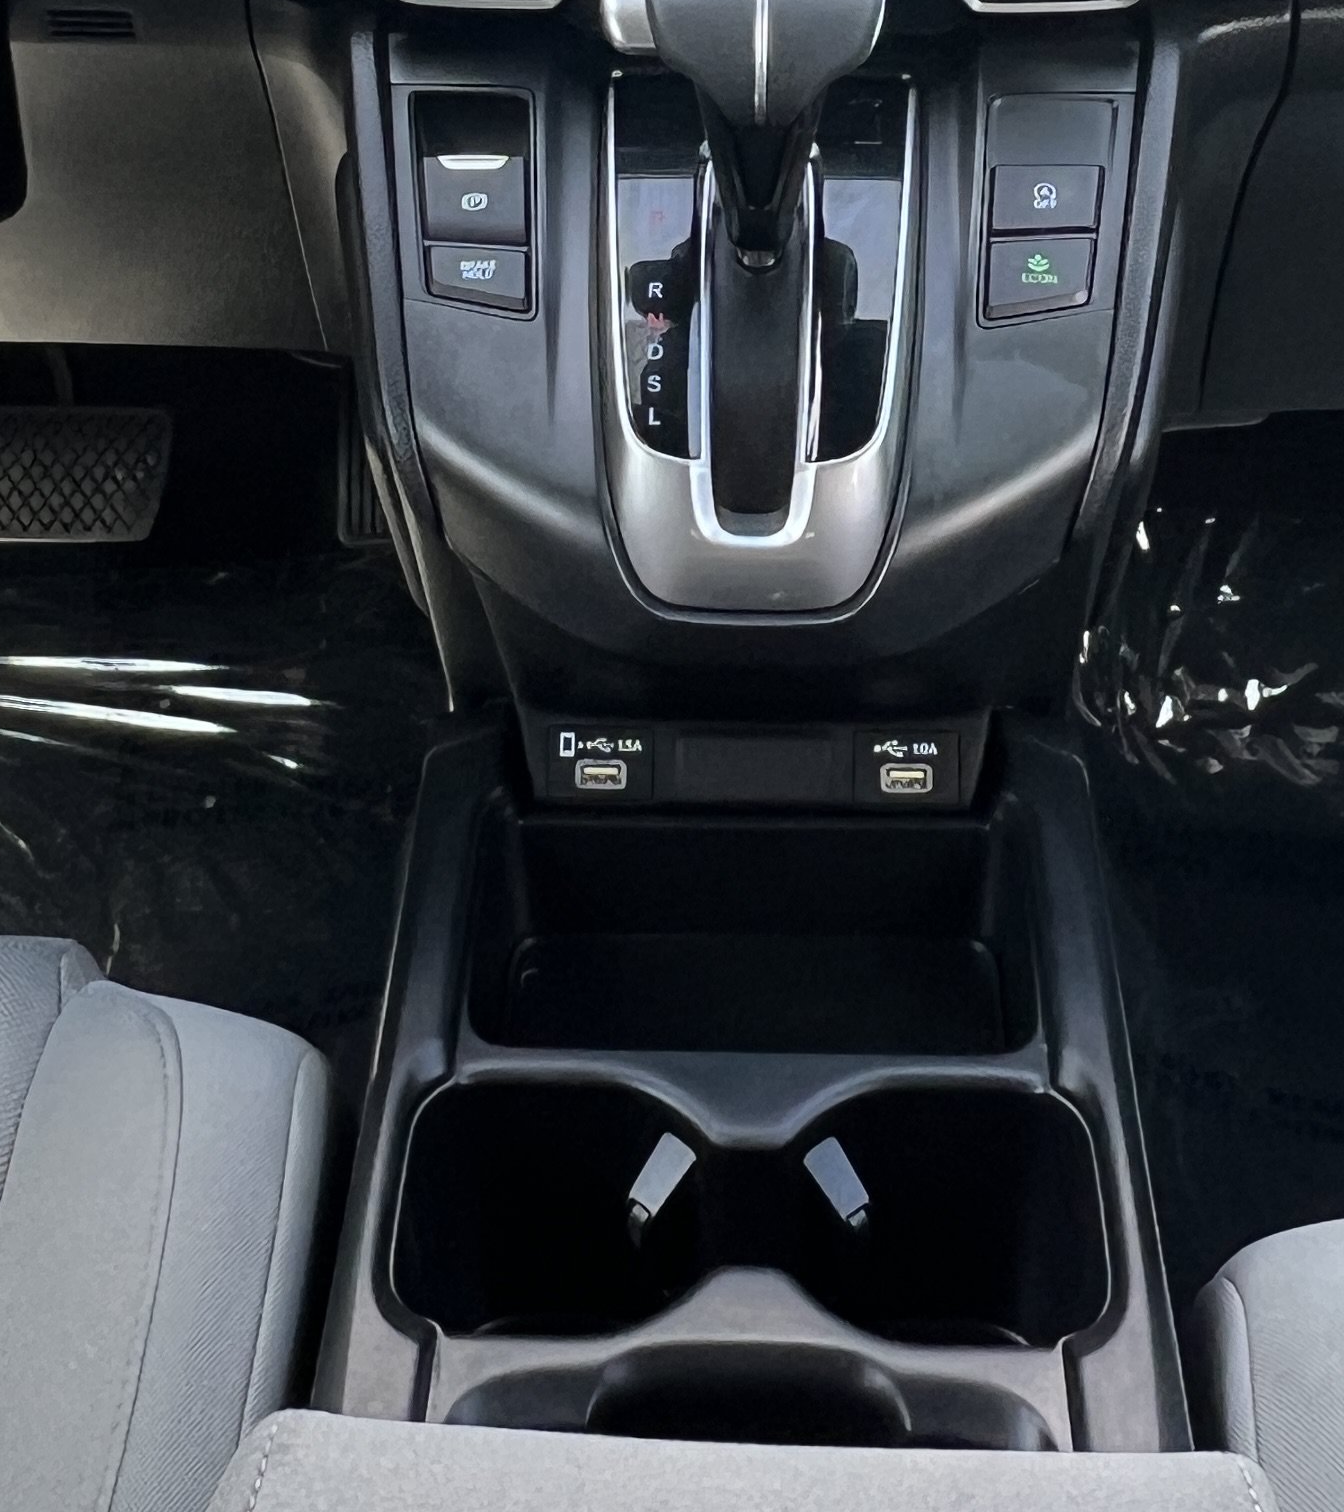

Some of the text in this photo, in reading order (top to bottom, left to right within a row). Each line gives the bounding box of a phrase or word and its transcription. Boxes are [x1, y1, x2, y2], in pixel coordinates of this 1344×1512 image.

[648, 282, 664, 299] R
[647, 343, 664, 361] D
[647, 374, 662, 393] S
[648, 407, 662, 426] L
